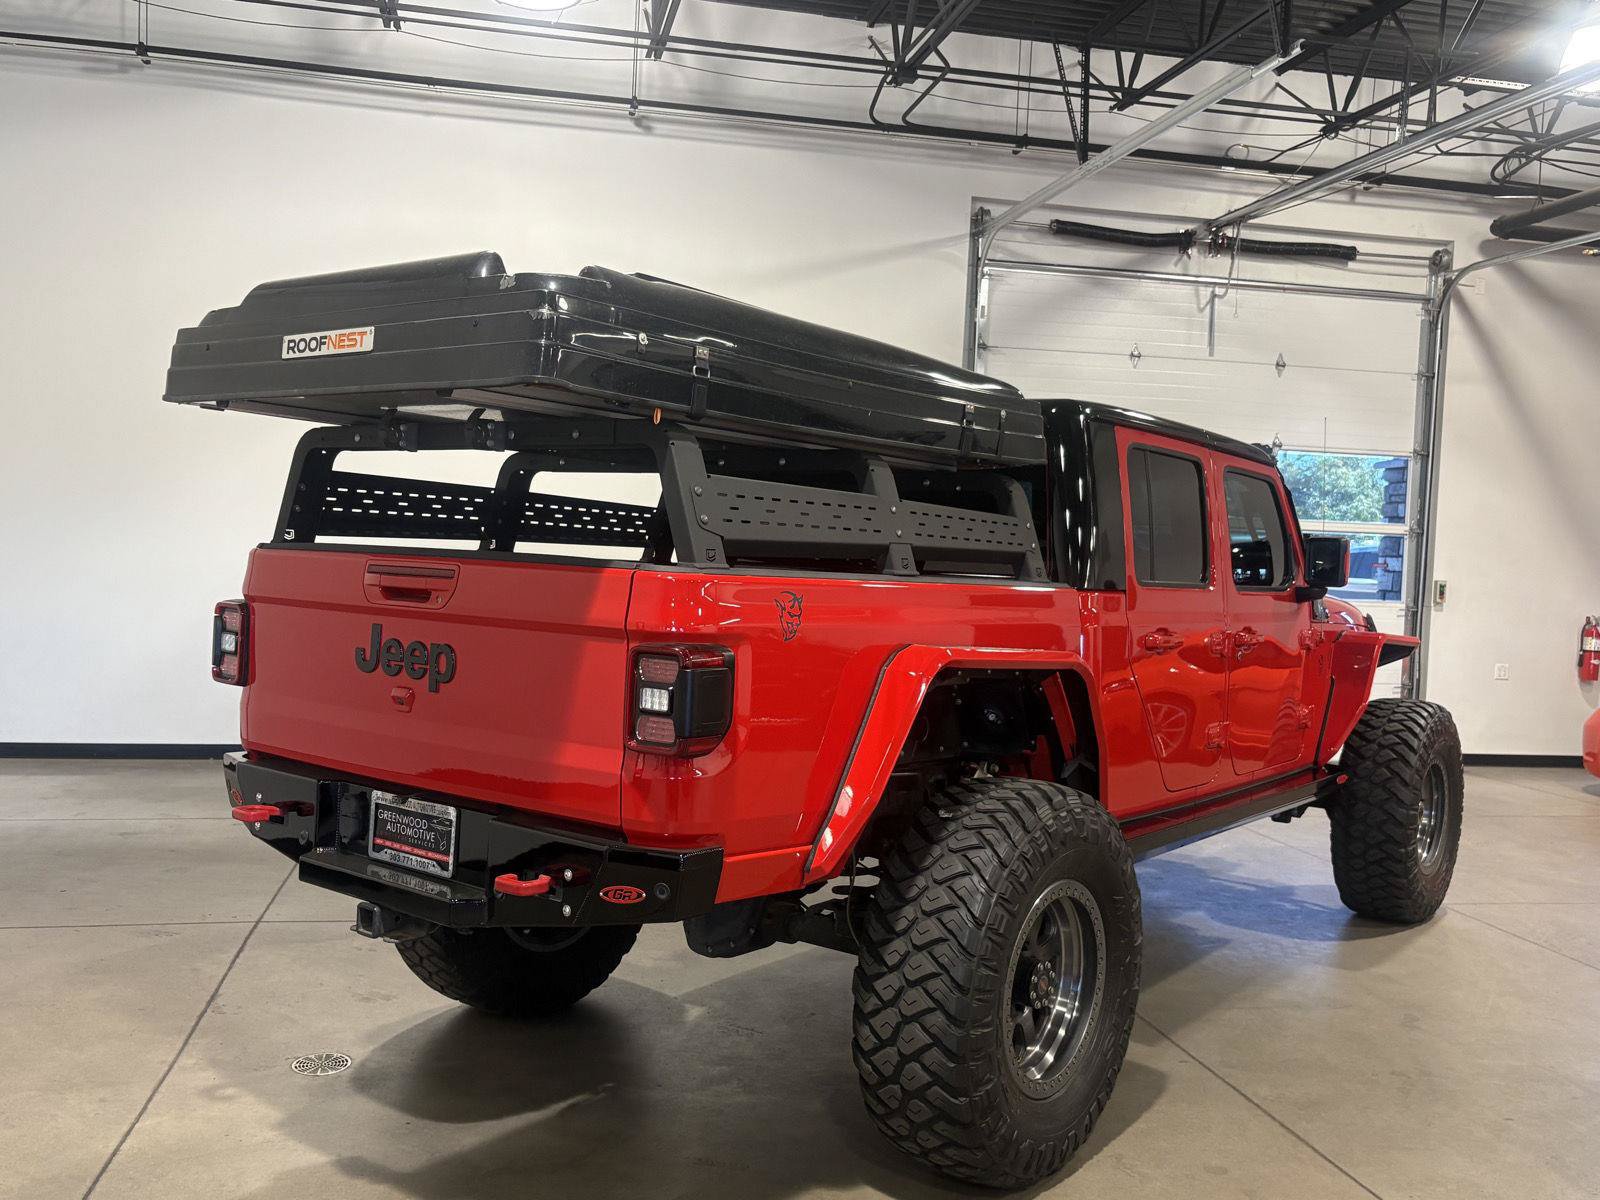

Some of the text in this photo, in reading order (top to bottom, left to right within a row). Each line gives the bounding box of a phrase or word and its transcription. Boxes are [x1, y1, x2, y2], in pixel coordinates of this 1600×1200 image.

[286, 331, 368, 355] ROOFNEST
[355, 623, 456, 693] Jeep
[377, 809, 428, 830] GREENWOOD
[386, 821, 436, 842] AUTOMOTIVE
[408, 837, 436, 849] SERVICES
